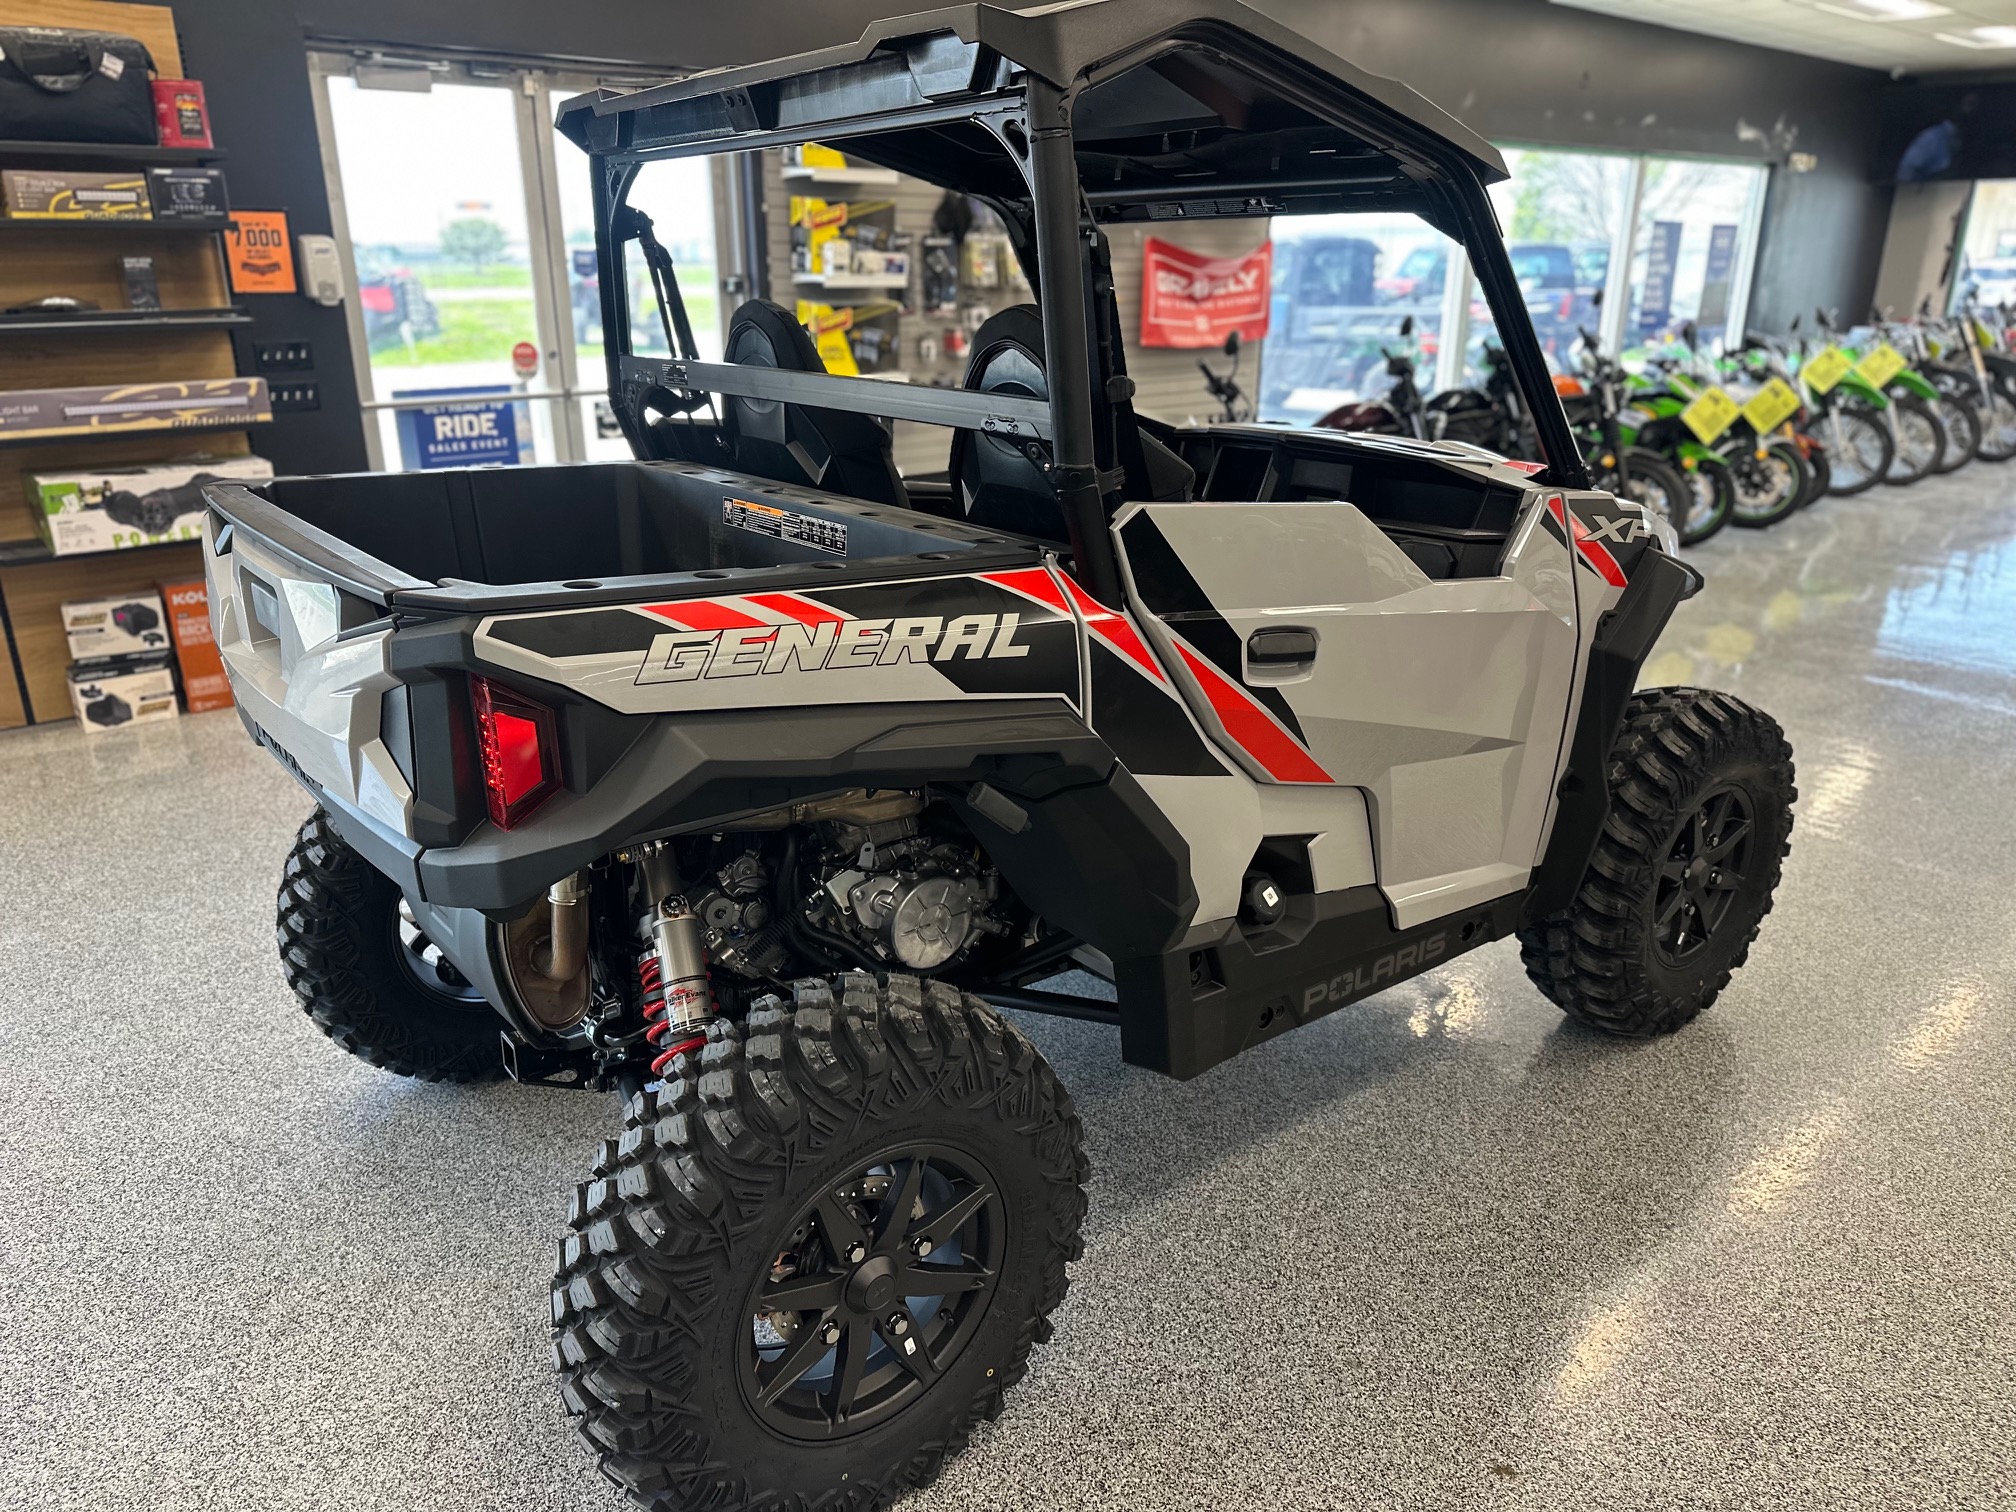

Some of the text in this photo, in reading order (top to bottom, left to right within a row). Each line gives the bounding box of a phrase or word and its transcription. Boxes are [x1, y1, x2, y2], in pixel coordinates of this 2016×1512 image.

[428, 437, 509, 454] SALES EVENT
[1579, 515, 1652, 544] XP
[634, 612, 1030, 686] GENERAL
[1303, 931, 1447, 1015] POLARIS
